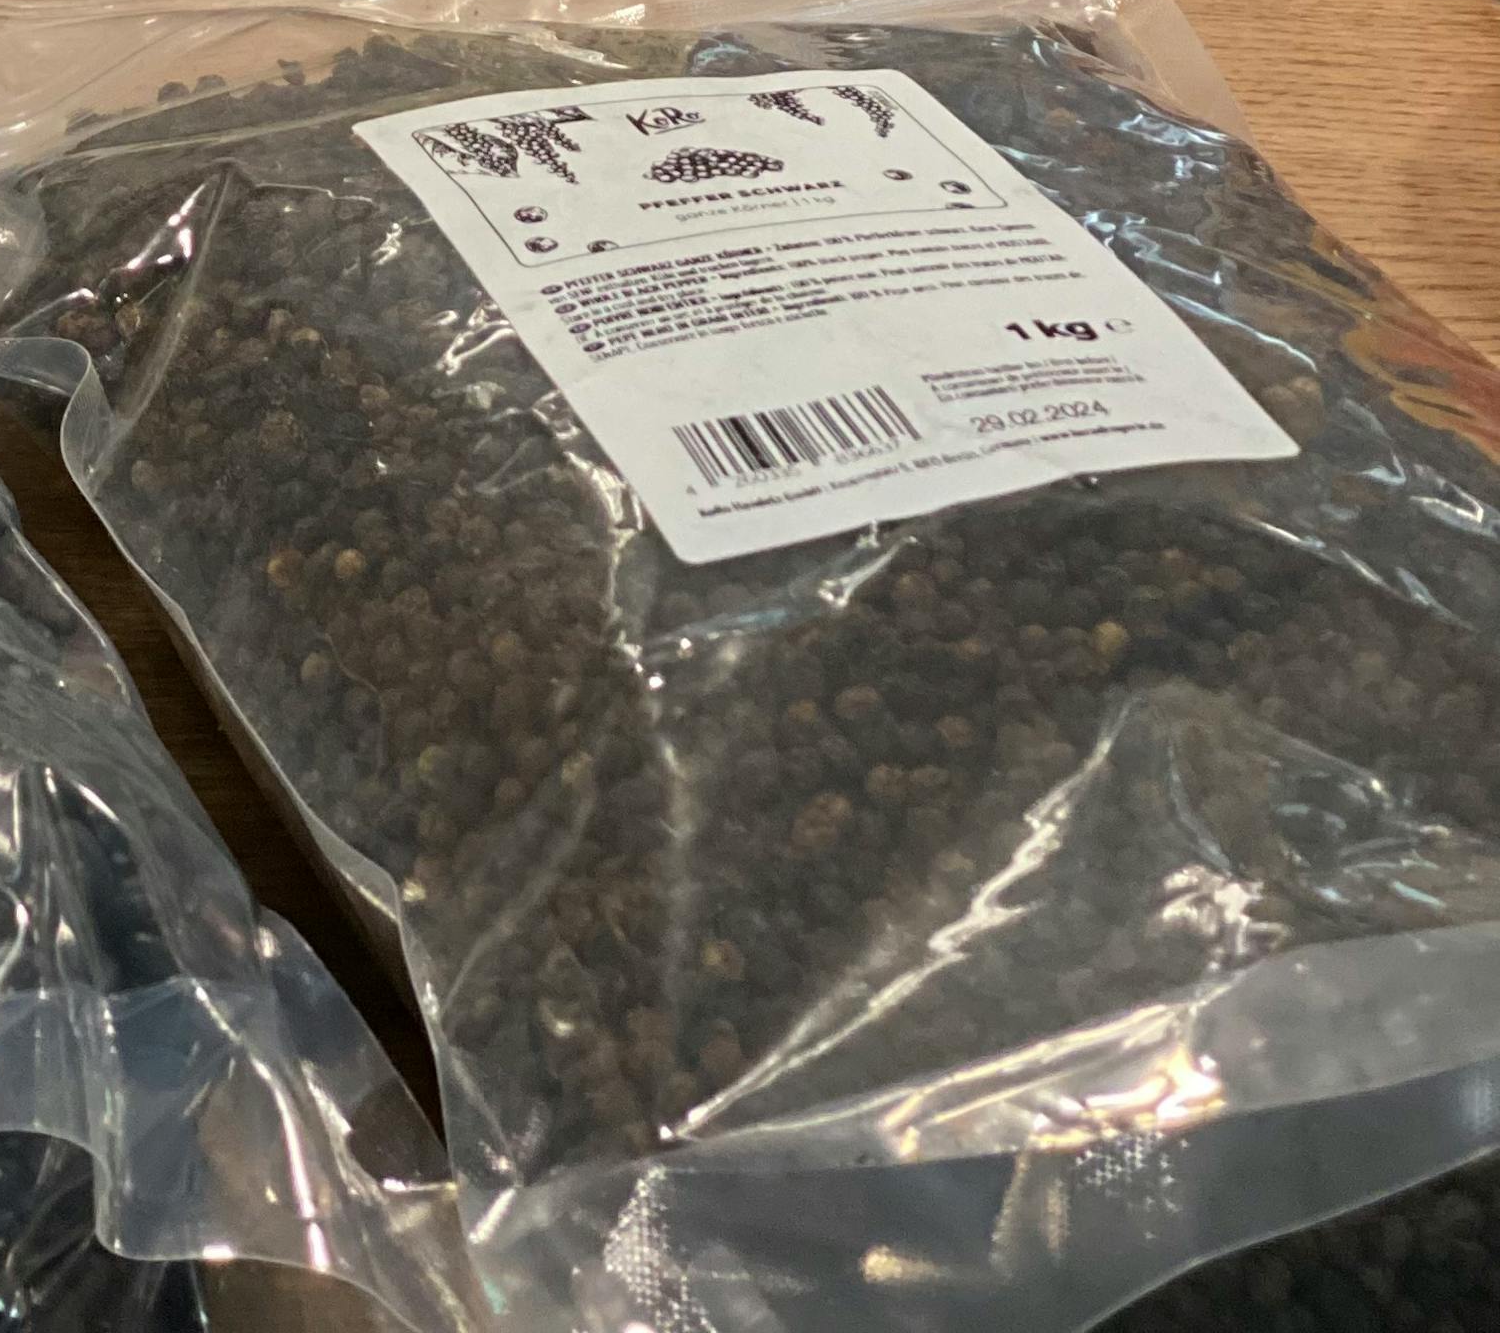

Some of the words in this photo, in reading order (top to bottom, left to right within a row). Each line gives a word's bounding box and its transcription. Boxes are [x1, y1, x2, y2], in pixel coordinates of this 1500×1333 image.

[626, 107, 706, 135] KoRo
[638, 193, 732, 210] PFEFFER
[738, 181, 845, 198] SCHWARZ
[1005, 321, 1031, 340] 1
[1033, 319, 1101, 341] kg
[970, 401, 1109, 433] 29.02.2024
